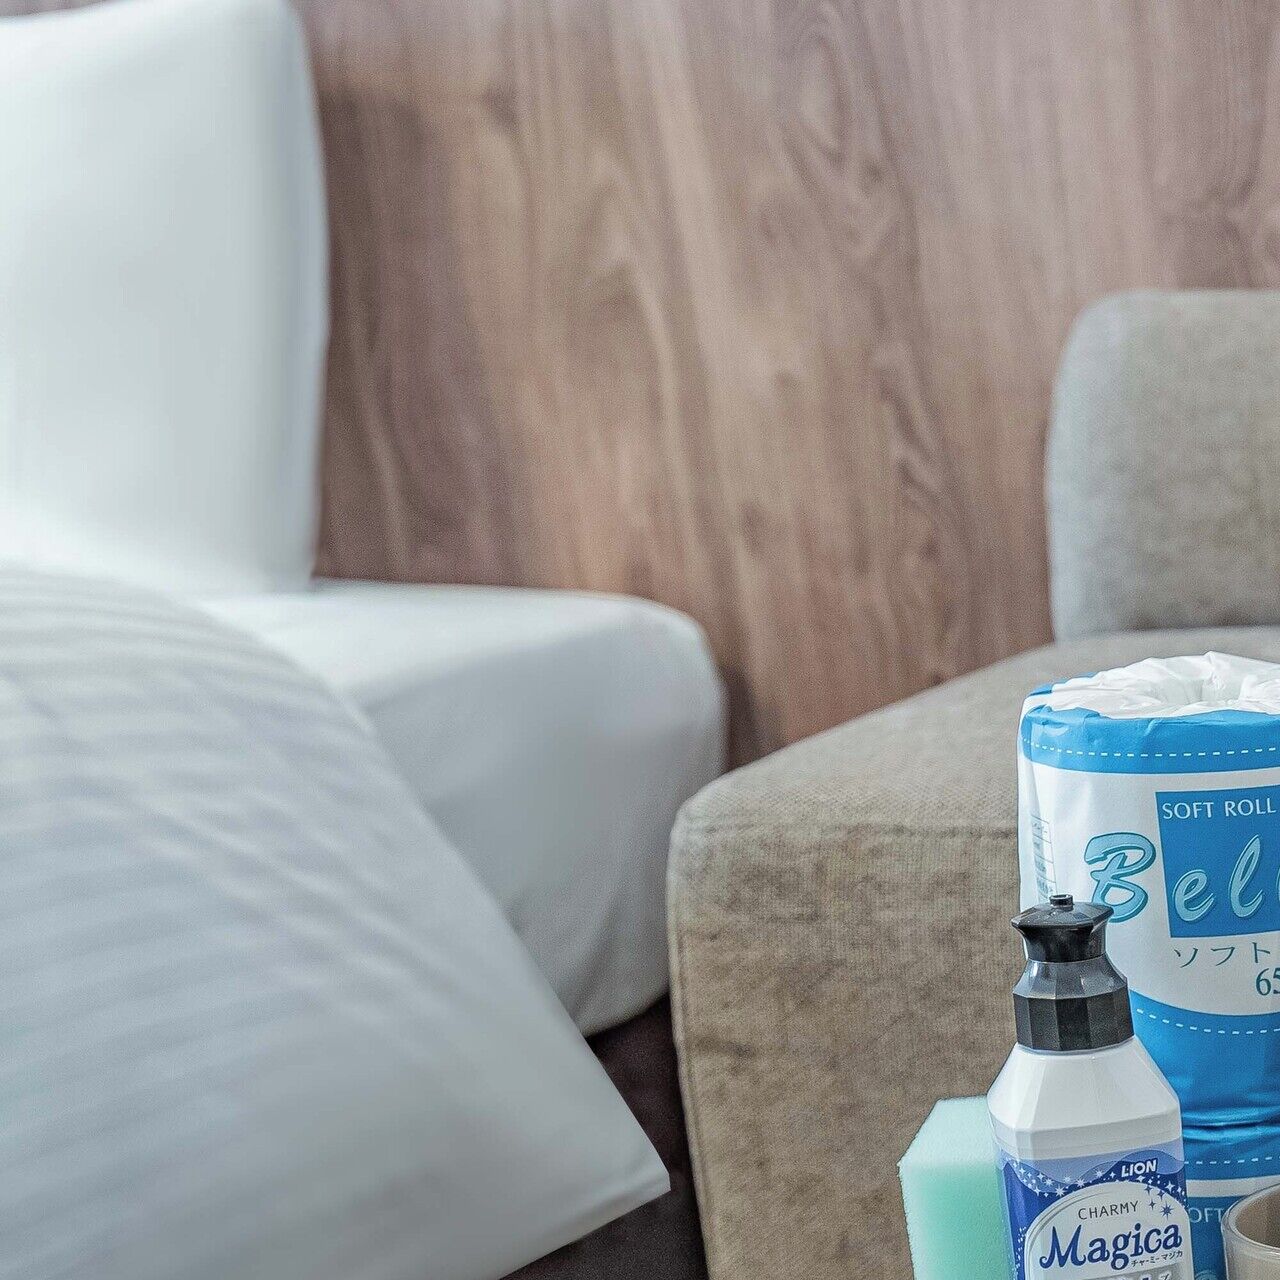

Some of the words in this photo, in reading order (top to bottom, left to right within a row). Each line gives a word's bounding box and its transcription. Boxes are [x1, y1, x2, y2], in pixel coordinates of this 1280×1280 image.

[1162, 802, 1214, 819] SOFT
[1225, 796, 1276, 817] ROLL
[1121, 1159, 1158, 1178] LION
[1078, 1200, 1139, 1220] CHARMY
[1187, 1207, 1224, 1223] OFT
[1039, 1222, 1183, 1271] Magica
